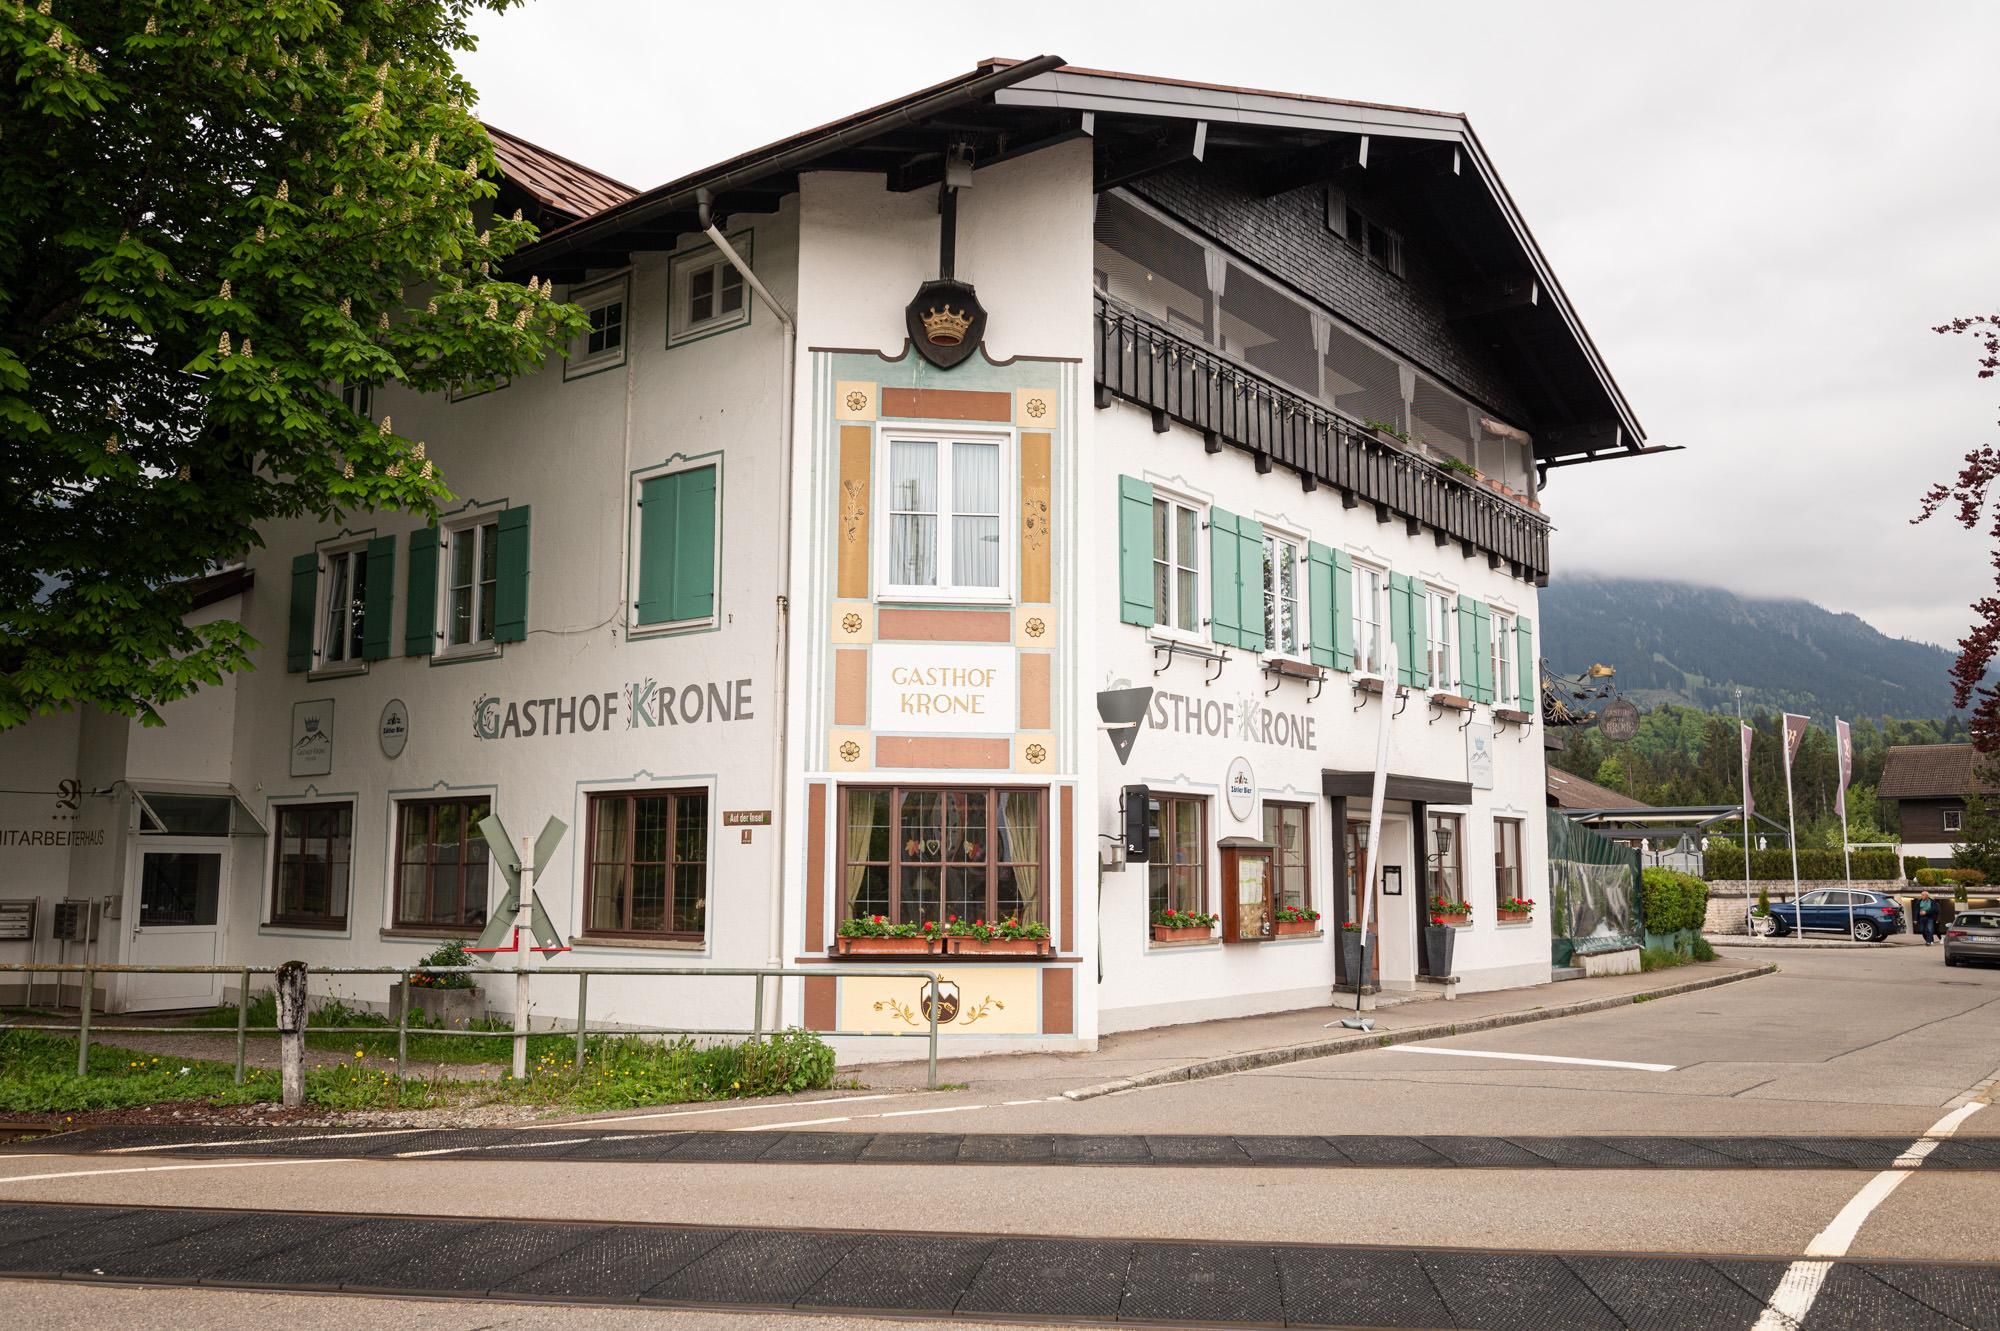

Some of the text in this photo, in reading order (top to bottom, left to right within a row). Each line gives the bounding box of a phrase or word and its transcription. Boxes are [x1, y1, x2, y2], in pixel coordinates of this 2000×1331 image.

[892, 667, 997, 688] GASTHOF
[474, 679, 754, 739] GASTHOF KRONE
[900, 693, 985, 716] KRONE
[1243, 699, 1317, 751] KRONE
[729, 812, 764, 823] Auf der Insel
